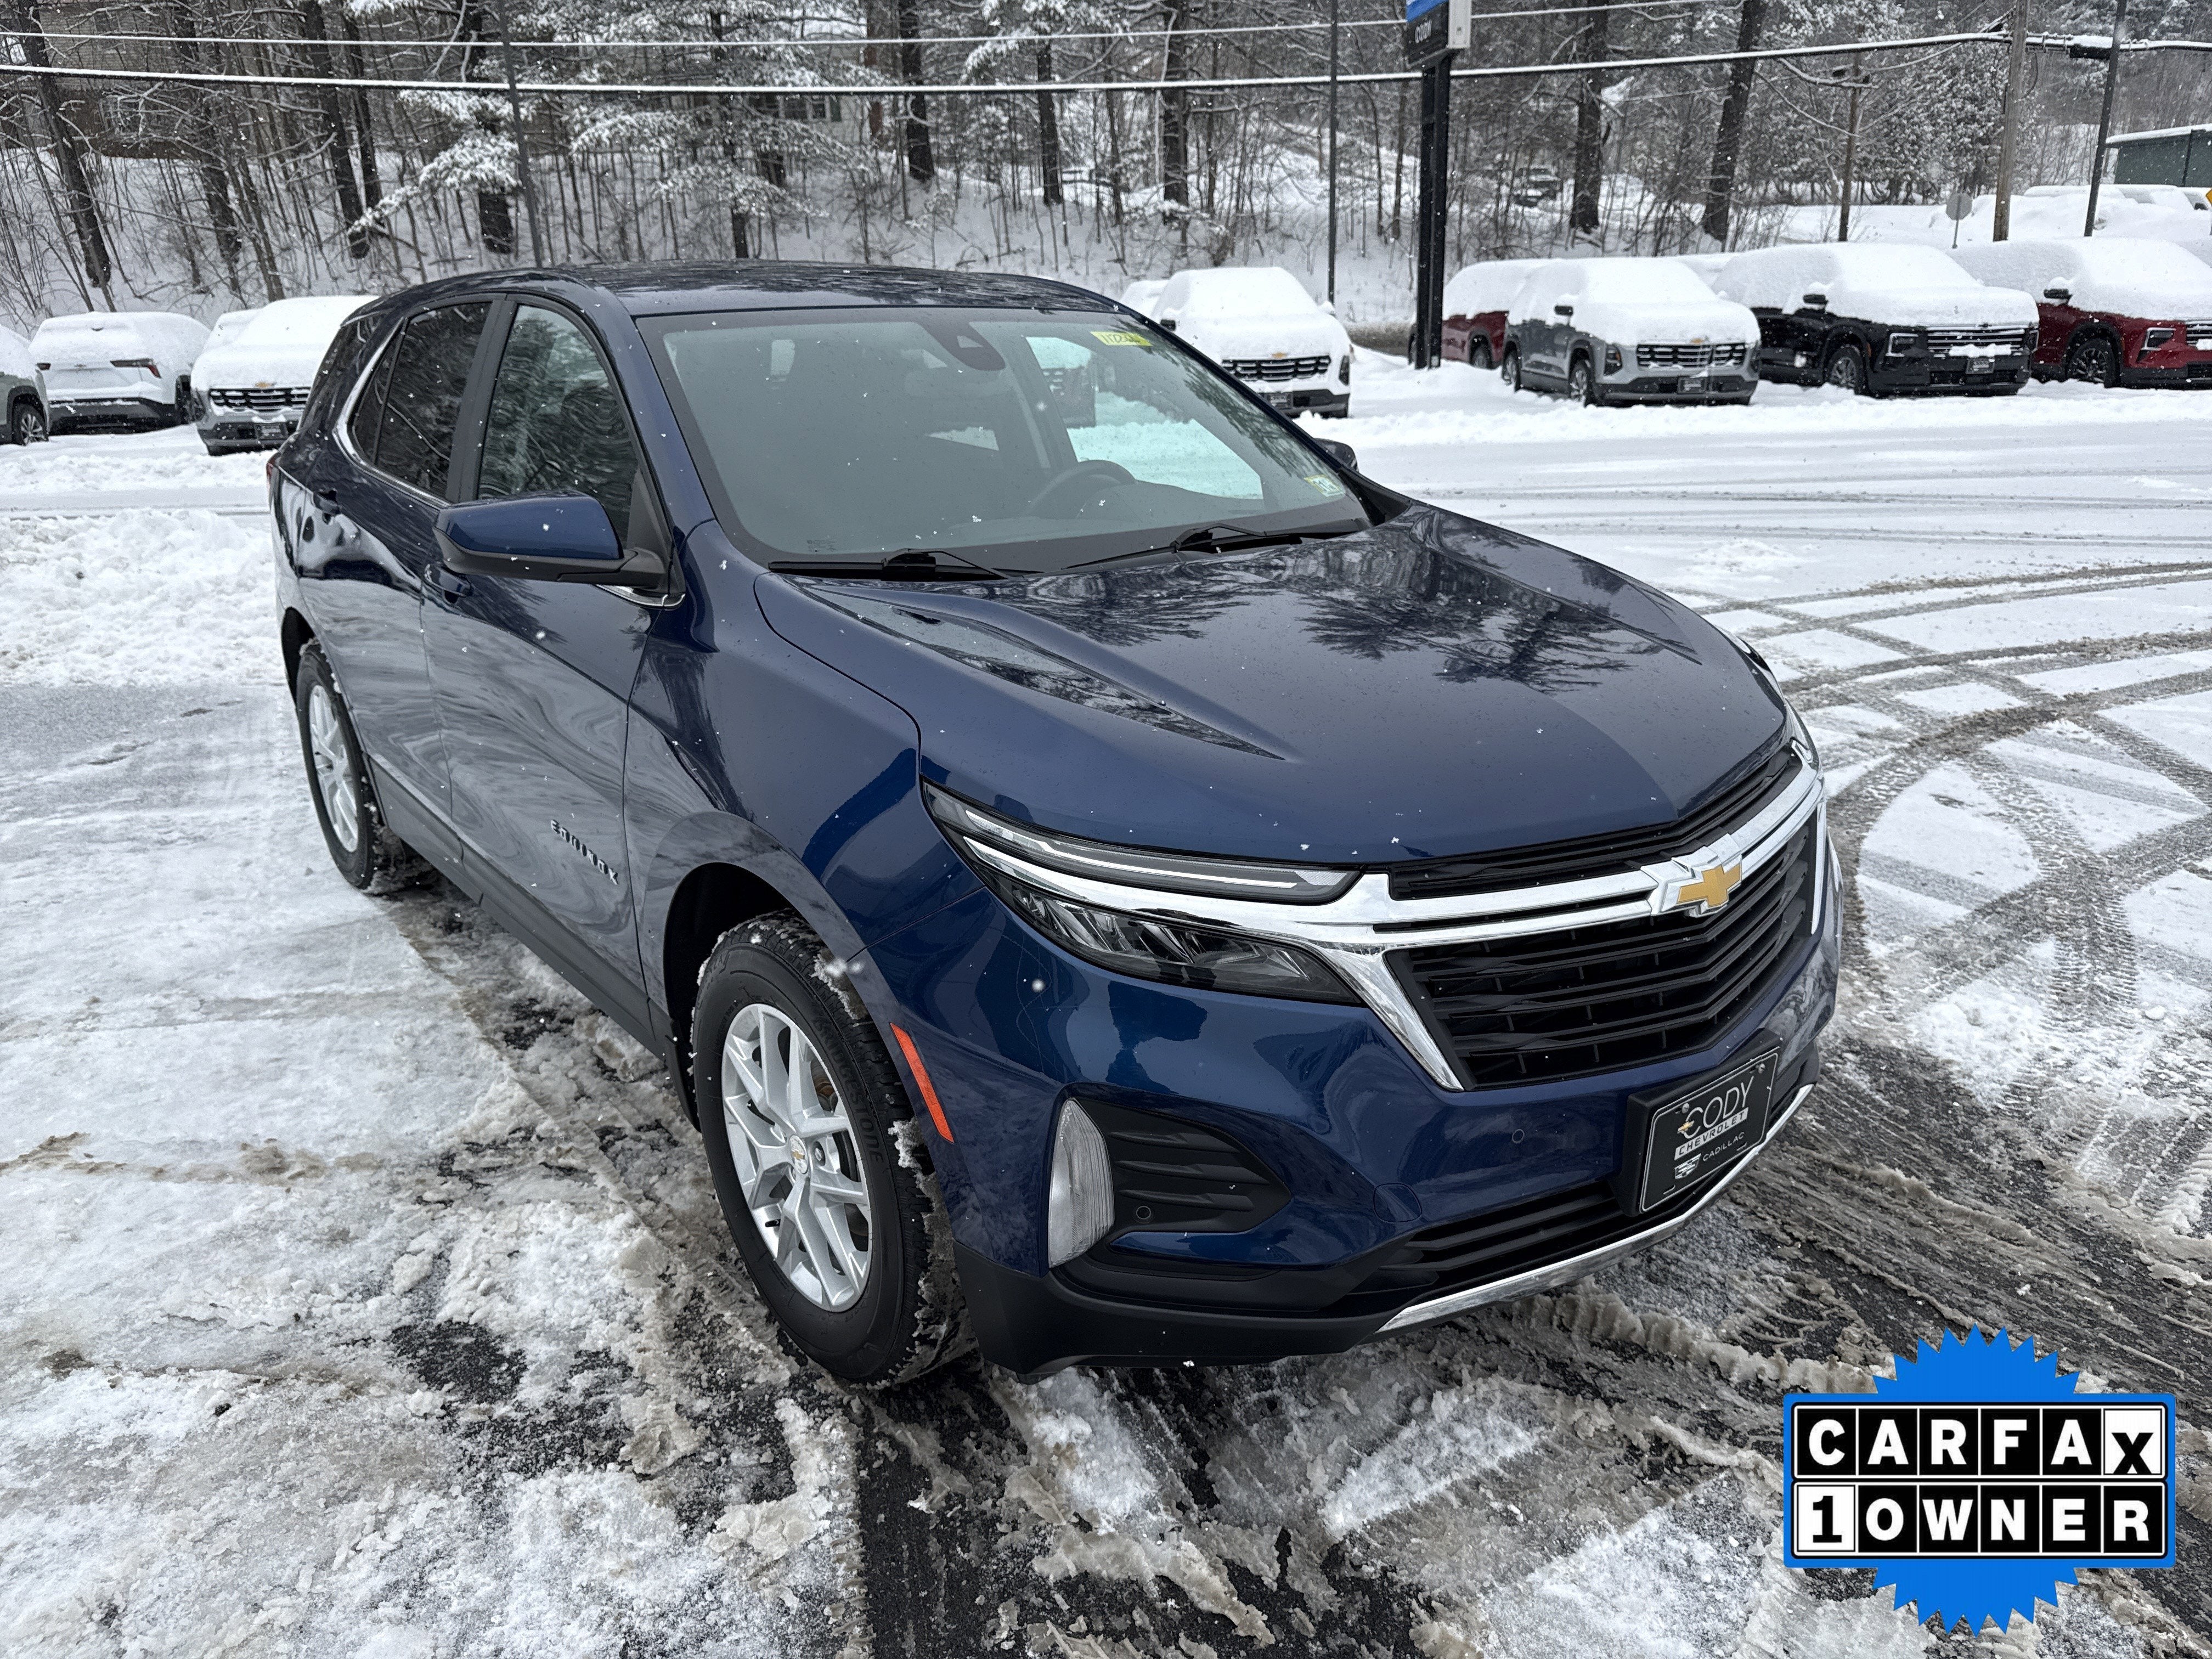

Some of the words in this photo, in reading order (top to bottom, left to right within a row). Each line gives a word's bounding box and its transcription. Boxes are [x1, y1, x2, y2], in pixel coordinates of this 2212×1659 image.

[550, 819, 619, 885] EQUINOX
[1678, 1109, 1747, 1156] CHEVROLET
[1681, 1075, 1754, 1139] CODY
[1702, 1131, 1745, 1161] CADILLAC
